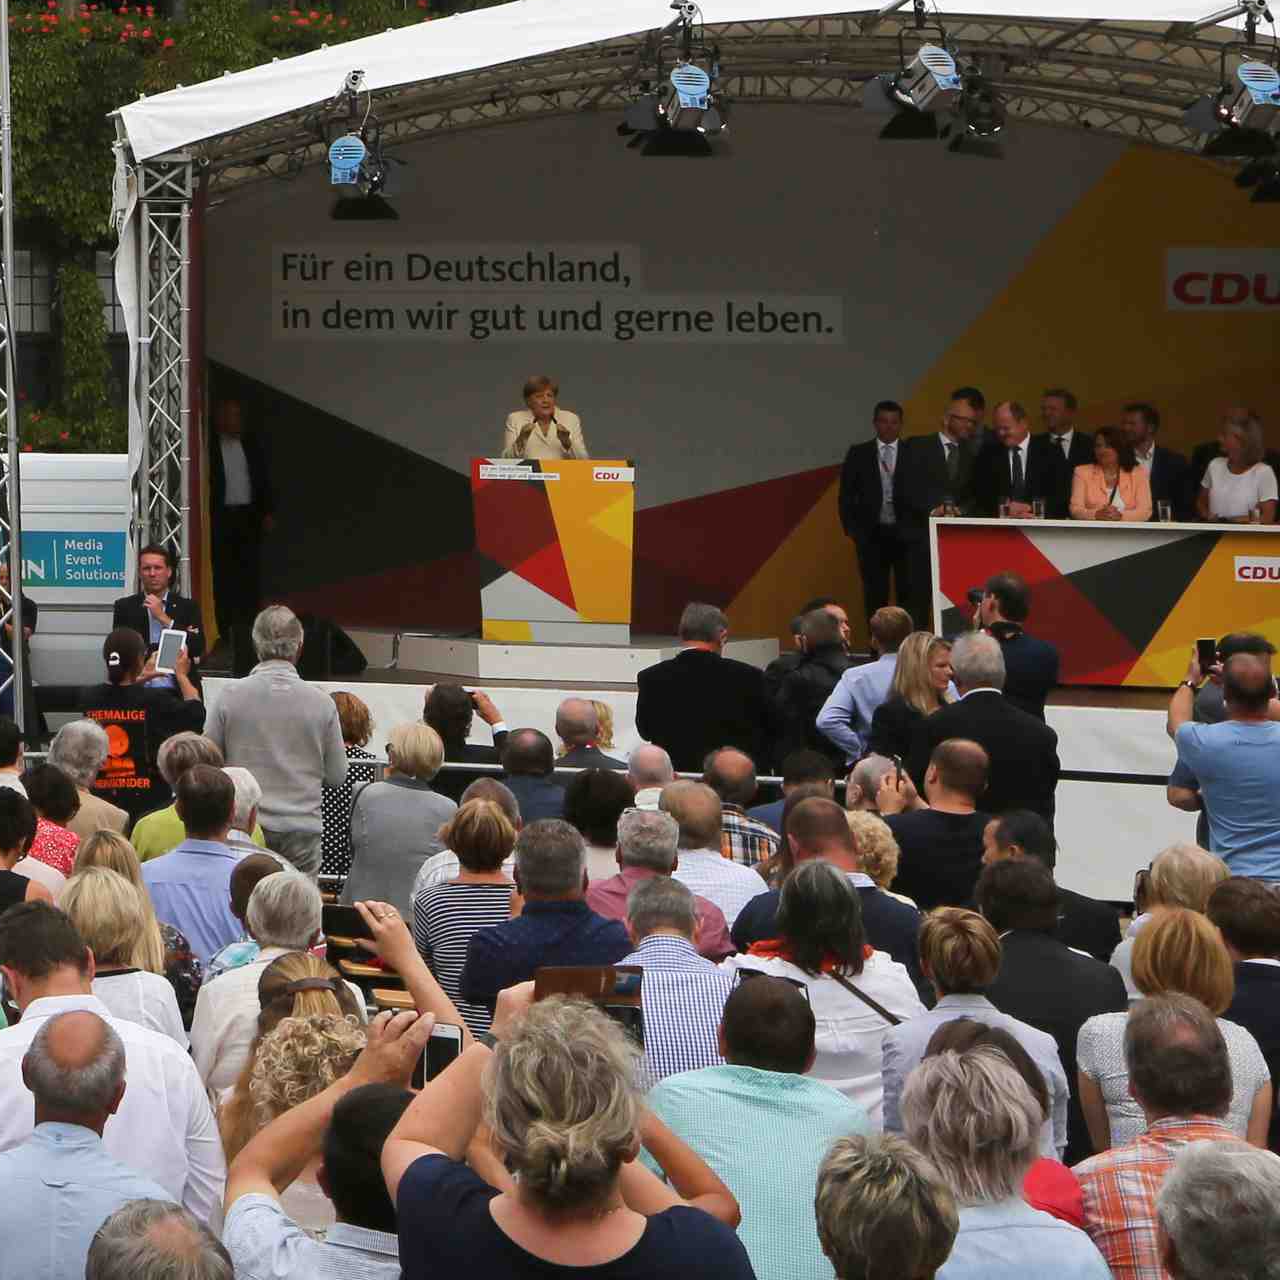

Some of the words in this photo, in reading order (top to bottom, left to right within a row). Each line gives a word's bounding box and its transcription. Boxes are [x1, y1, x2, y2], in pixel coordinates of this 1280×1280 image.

[282, 252, 334, 282] Für
[344, 252, 393, 282] ein
[406, 251, 632, 288] Deutschland,
[1174, 271, 1280, 305] CDU
[281, 300, 311, 329] in
[322, 299, 395, 330] dem
[405, 301, 460, 330] wir
[469, 304, 526, 340] gut
[538, 300, 602, 331] und
[614, 308, 714, 341] gerne
[726, 301, 834, 334] leben.
[595, 472, 620, 480] CDU
[64, 539, 104, 551] Media
[64, 554, 103, 566] Event
[65, 568, 126, 581] Solutions
[1237, 566, 1280, 580] CDU
